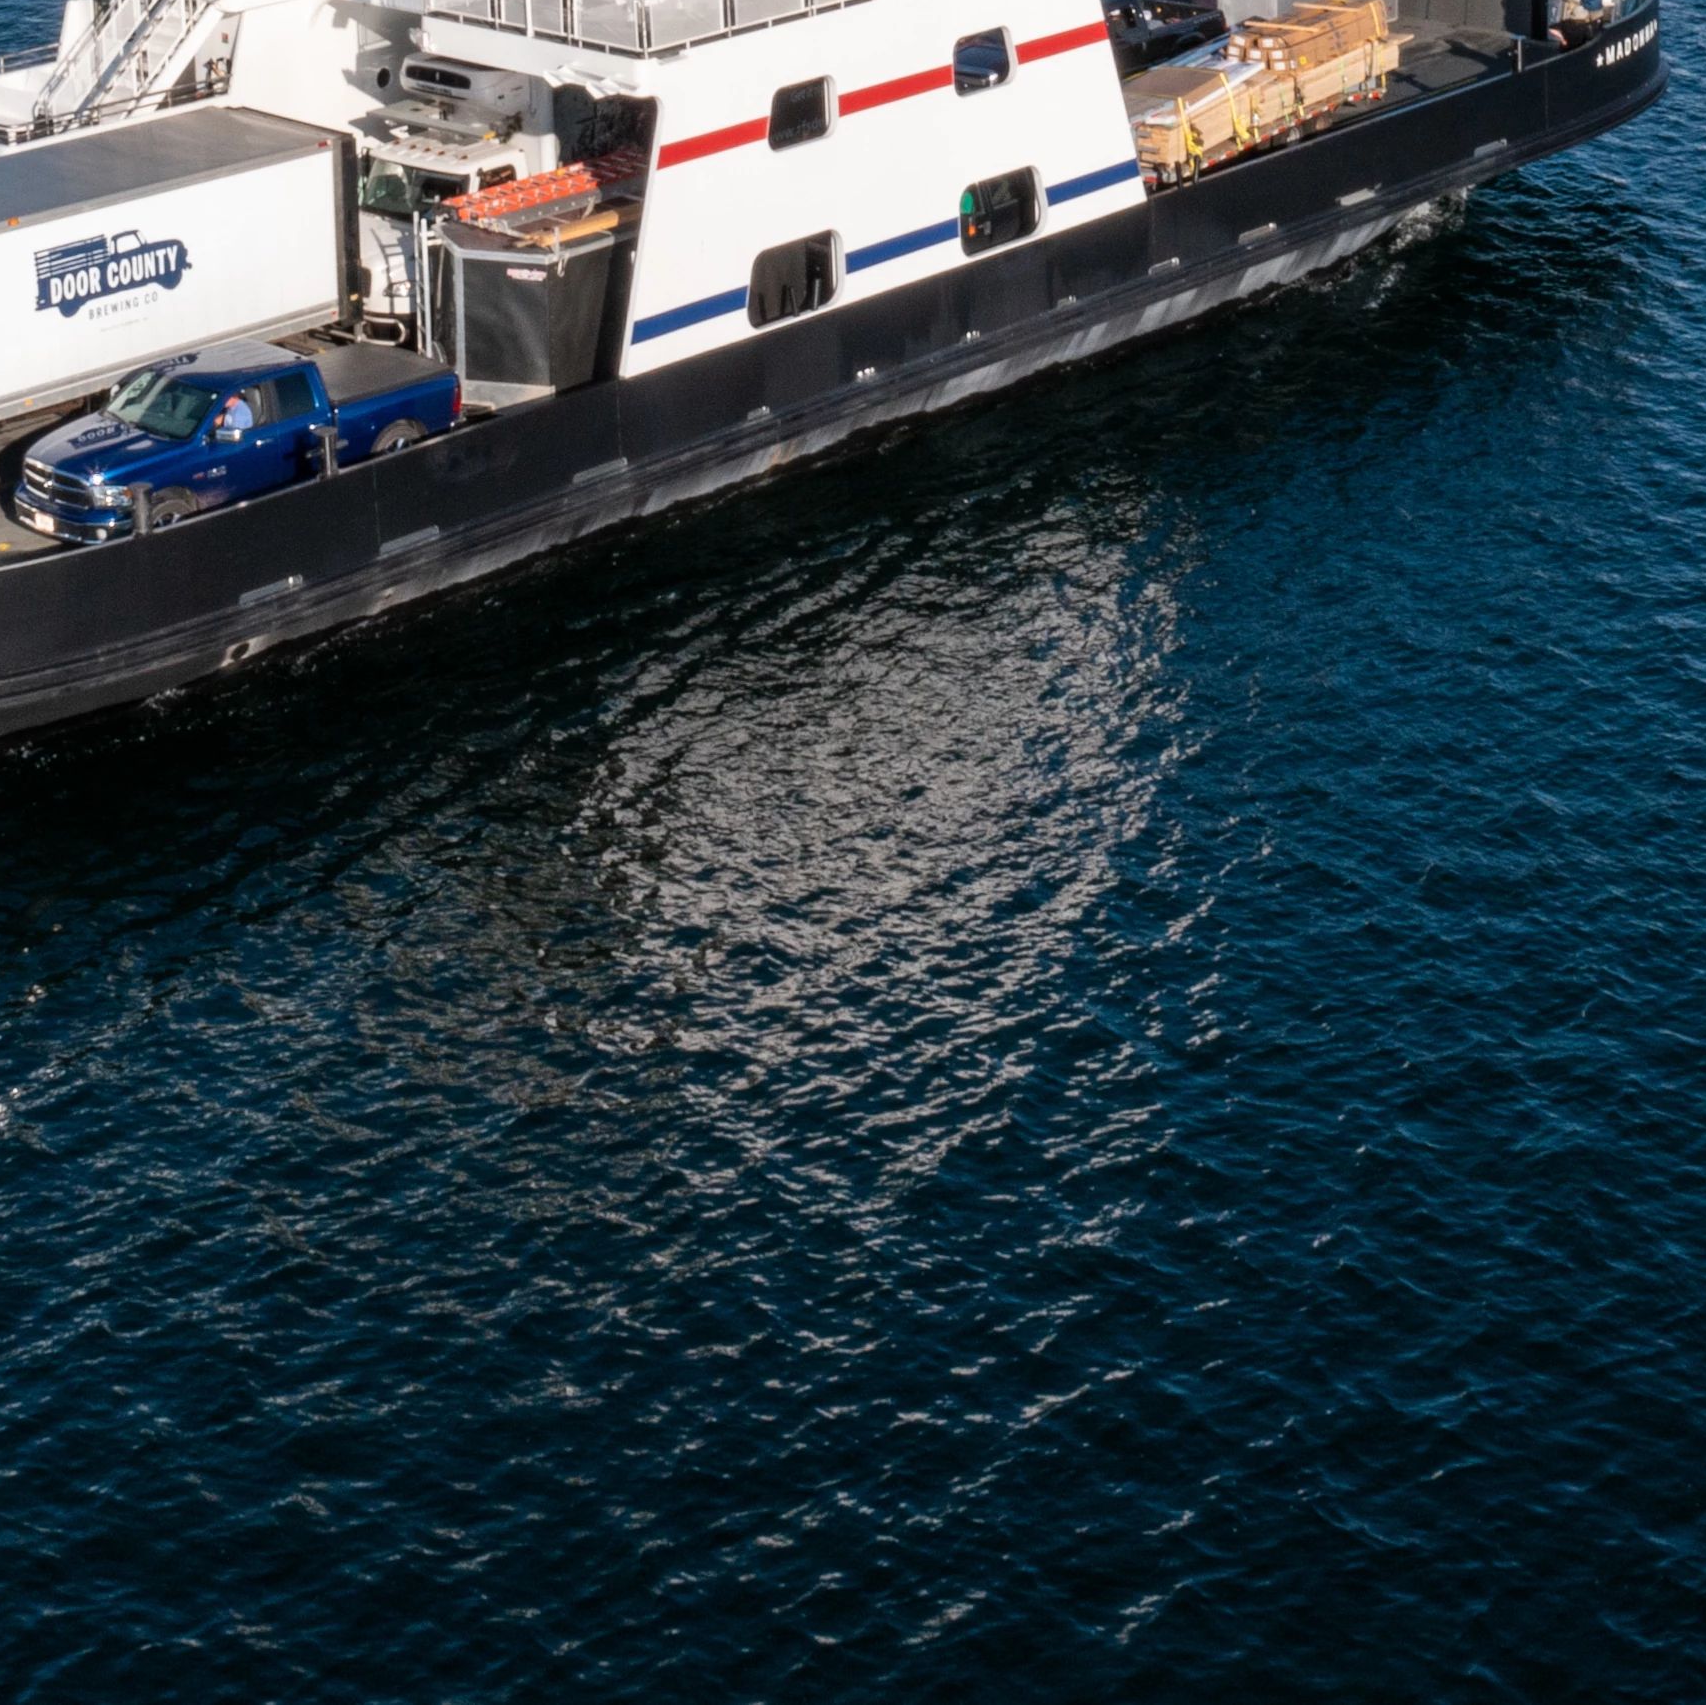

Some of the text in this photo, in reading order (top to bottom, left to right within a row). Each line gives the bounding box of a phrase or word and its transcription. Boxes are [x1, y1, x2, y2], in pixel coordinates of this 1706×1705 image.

[50, 245, 179, 305] DOOR COUNTY
[88, 291, 159, 321] BREWING CO
